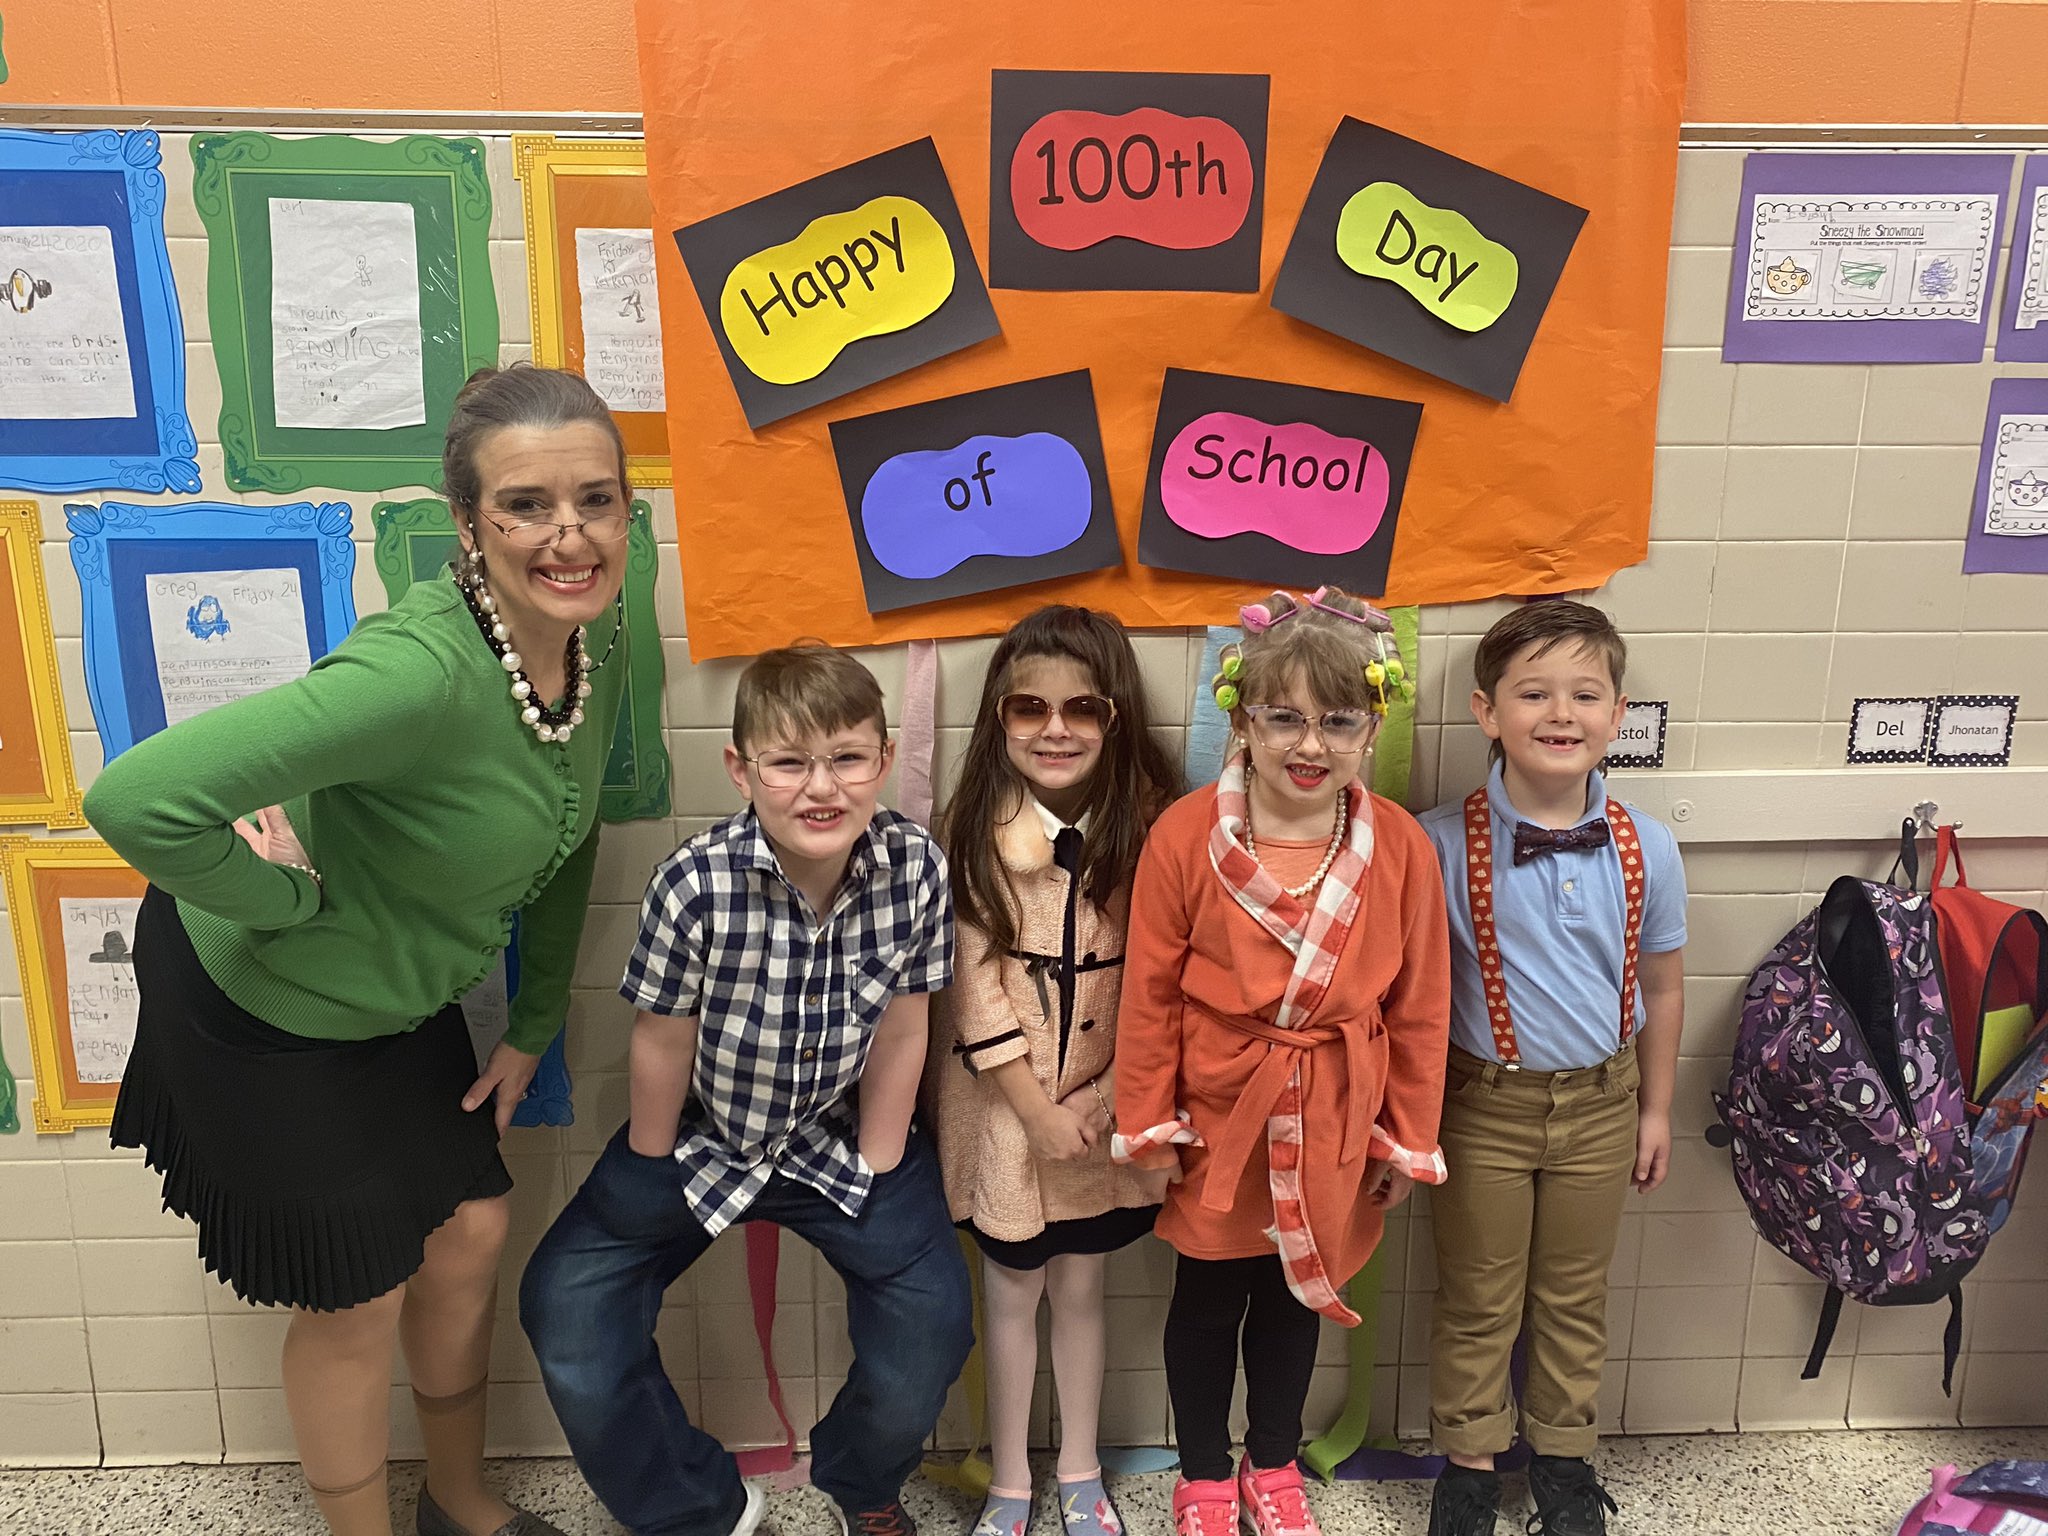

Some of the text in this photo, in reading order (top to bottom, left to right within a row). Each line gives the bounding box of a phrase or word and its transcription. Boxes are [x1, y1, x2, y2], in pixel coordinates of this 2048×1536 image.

[739, 133, 1480, 337] Happy 100th Day
[1820, 223, 1925, 238] Sneezy the Snowman!
[943, 434, 1370, 512] of School
[155, 581, 297, 605] Greg Friday 24
[1617, 725, 1649, 740] istol
[1876, 720, 1904, 736] Del
[1948, 724, 1999, 735] Jhonatan
